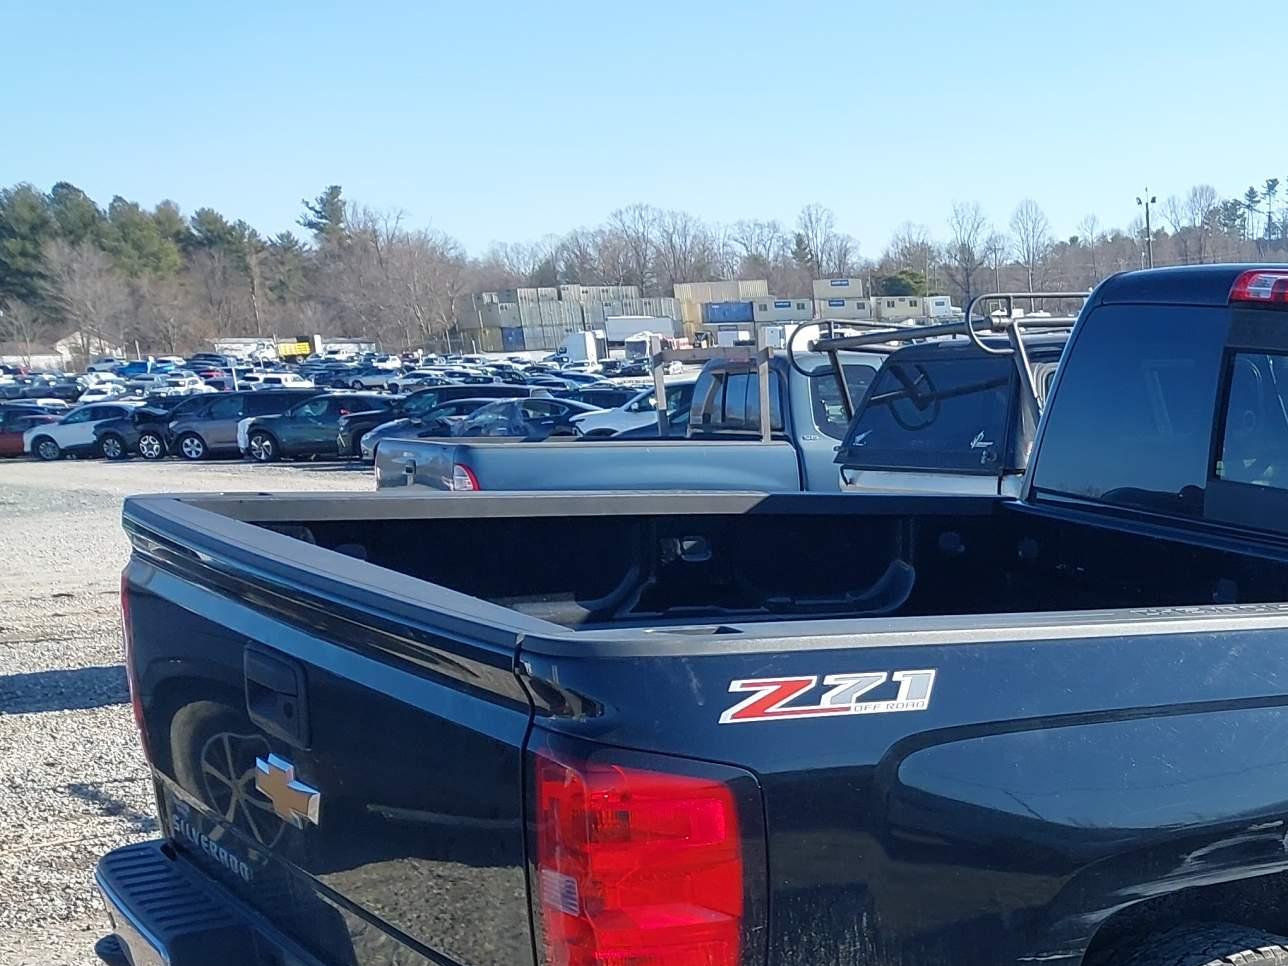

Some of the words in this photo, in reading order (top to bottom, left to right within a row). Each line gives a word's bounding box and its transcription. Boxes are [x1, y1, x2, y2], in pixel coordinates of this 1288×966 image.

[718, 669, 938, 724] Z71
[853, 702, 879, 713] OFF
[886, 700, 925, 711] ROAD
[173, 813, 250, 883] SILVERADO
